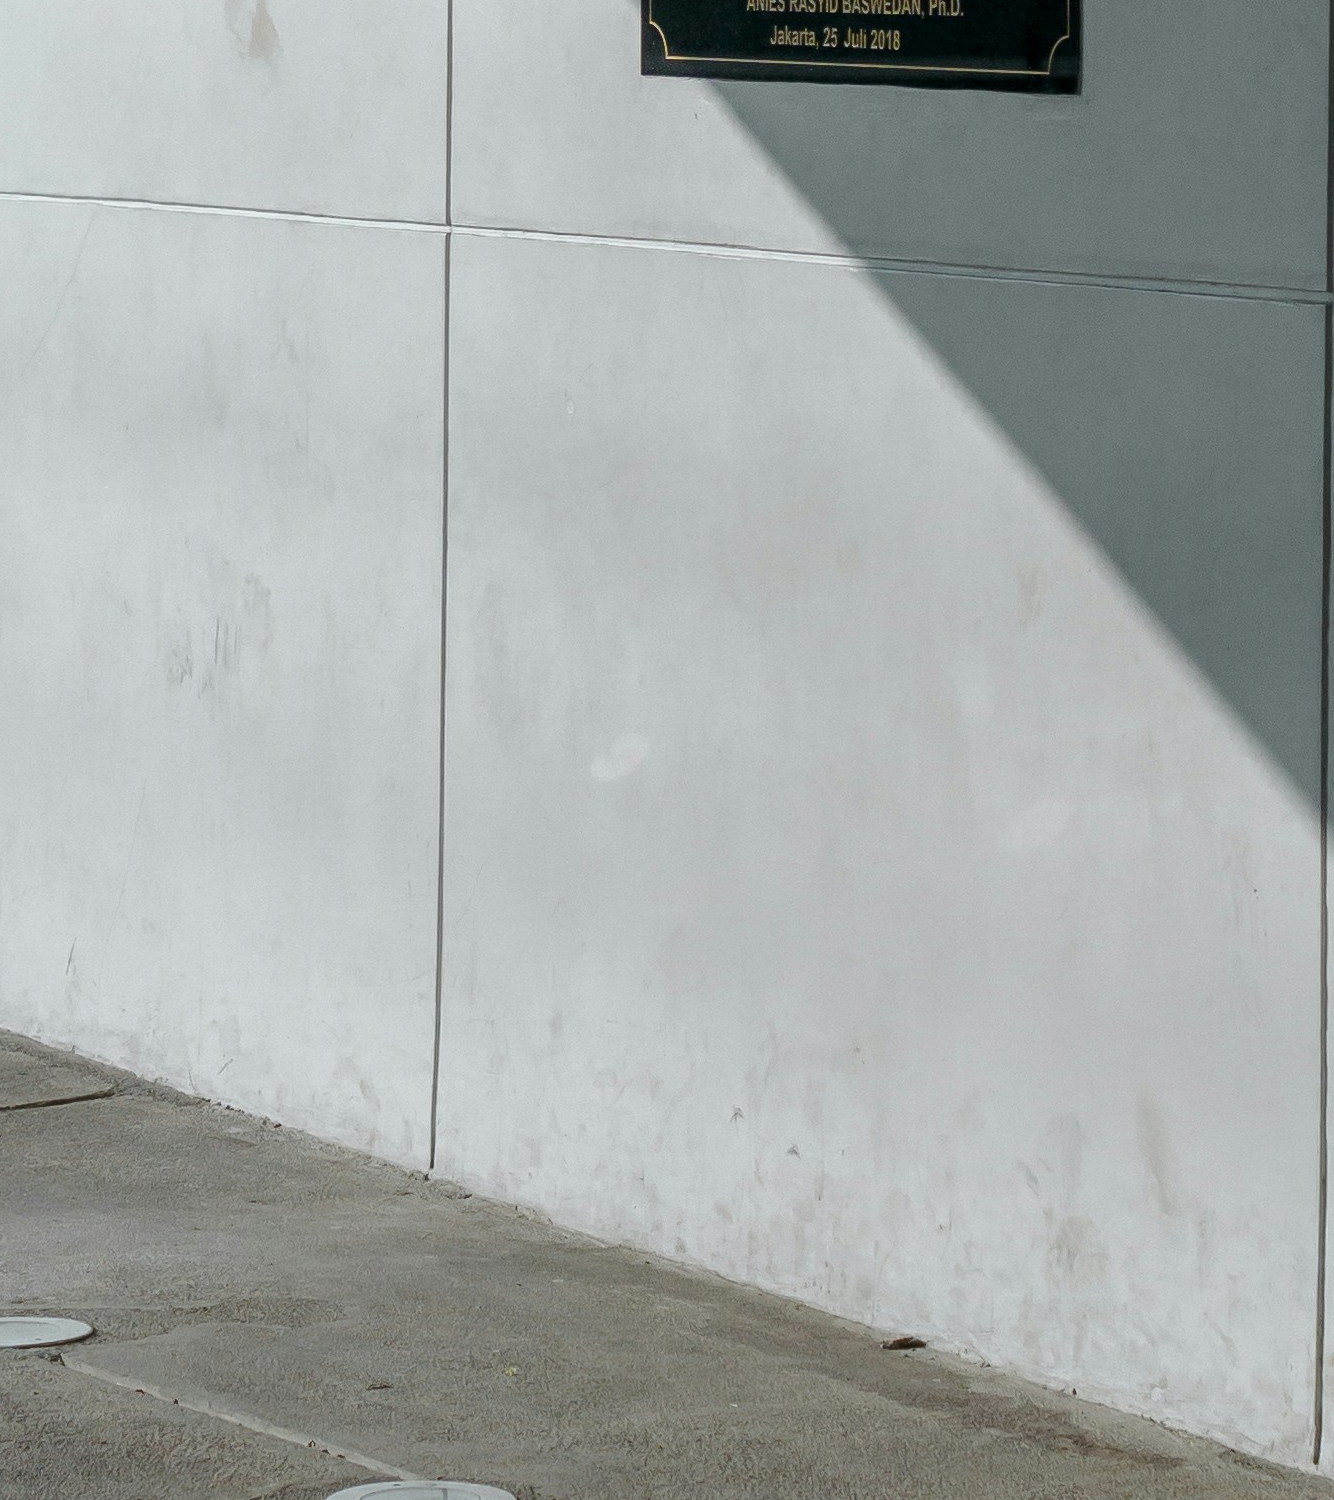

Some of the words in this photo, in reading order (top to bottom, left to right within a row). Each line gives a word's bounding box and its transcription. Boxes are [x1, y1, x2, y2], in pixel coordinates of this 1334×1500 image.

[770, 25, 819, 50] Jakarta,
[823, 27, 838, 47] 25
[843, 28, 867, 49] Juli
[870, 29, 901, 51] 2018
